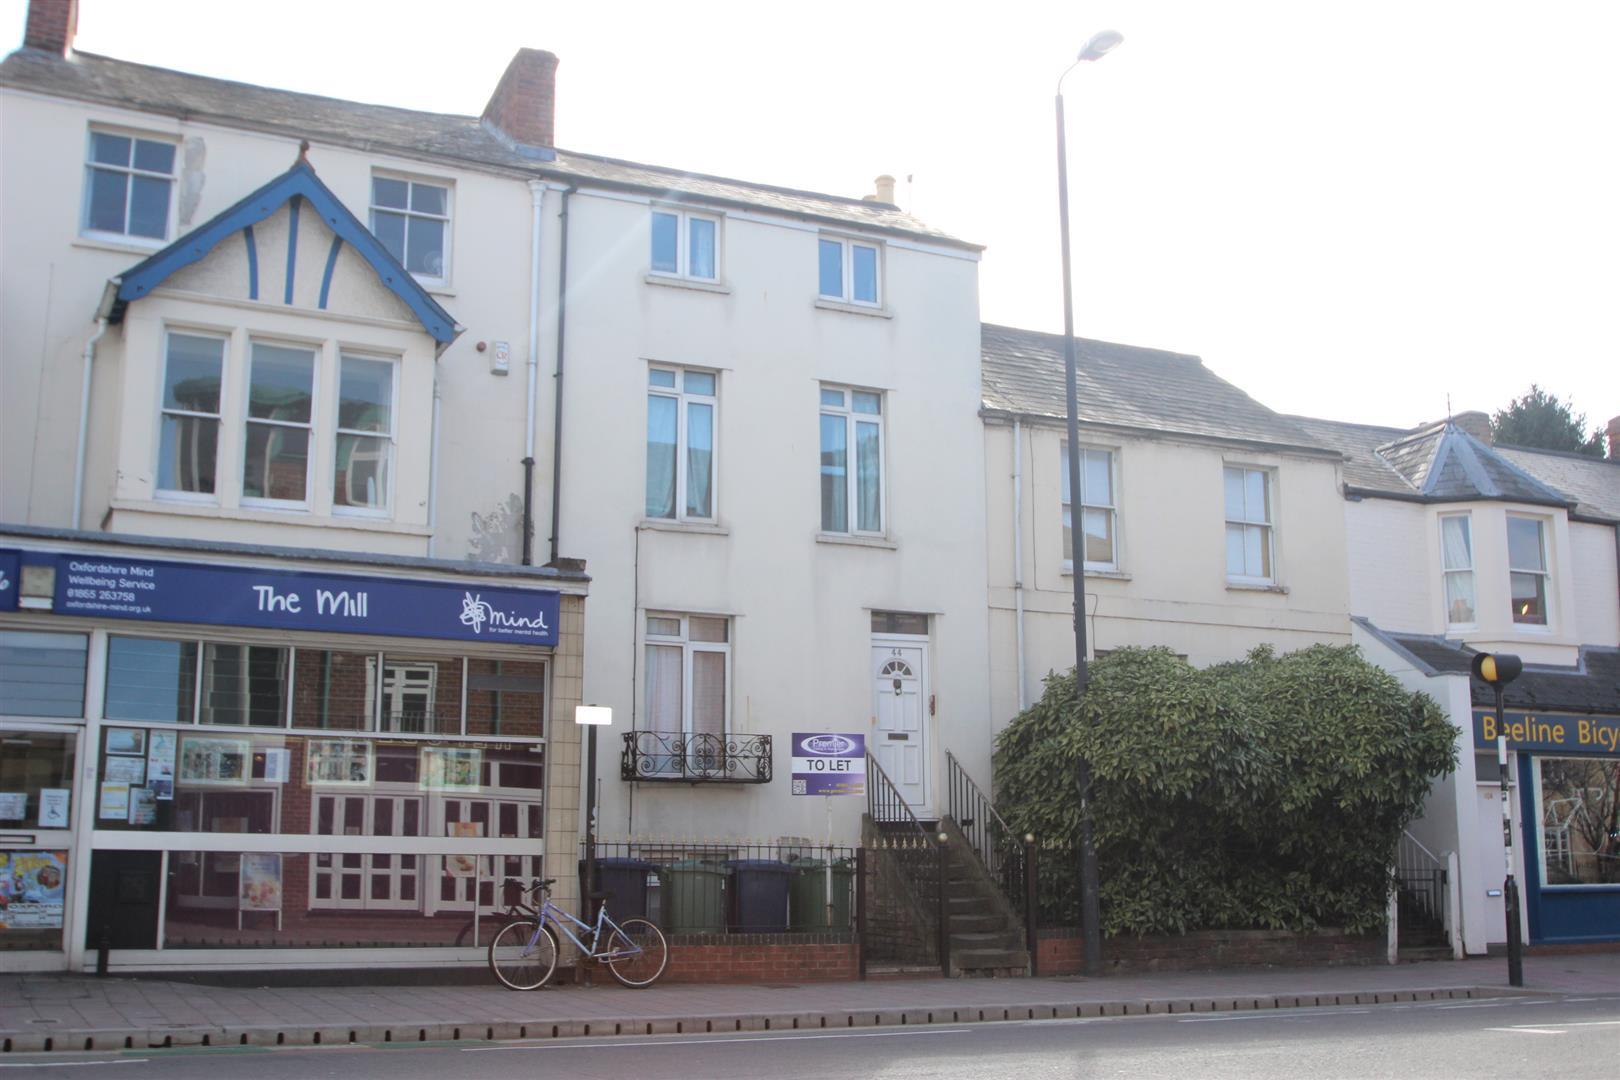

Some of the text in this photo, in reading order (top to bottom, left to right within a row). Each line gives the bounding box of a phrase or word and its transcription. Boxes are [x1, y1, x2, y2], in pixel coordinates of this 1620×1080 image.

[69, 561, 154, 577] Oxfordshire Mind
[68, 575, 155, 590] Wellbeing Service
[66, 588, 135, 602] 01865 263758
[252, 585, 367, 617] The Mill
[65, 601, 151, 613] oxfordshire-mind.org.uk
[488, 608, 548, 629] mind
[1577, 719, 1620, 752] Bicy
[806, 759, 852, 771] TO LET
